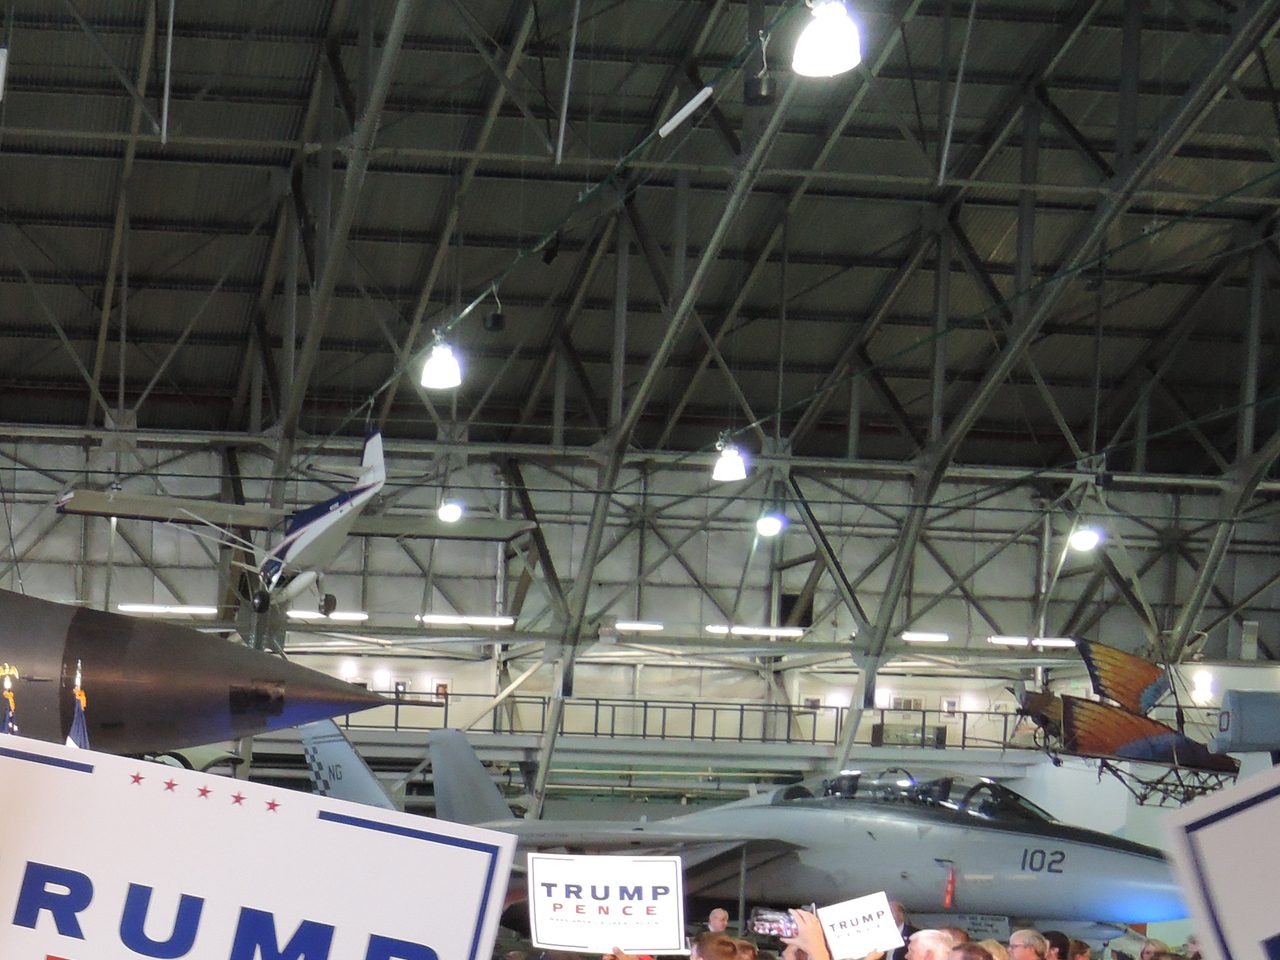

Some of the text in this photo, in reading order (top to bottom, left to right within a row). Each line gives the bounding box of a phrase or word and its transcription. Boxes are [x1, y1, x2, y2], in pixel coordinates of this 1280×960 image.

[328, 764, 343, 781] NG
[1021, 848, 1066, 874] 102
[540, 882, 671, 901] TRUMP
[552, 903, 657, 916] PENCE
[829, 910, 886, 932] TRUMP
